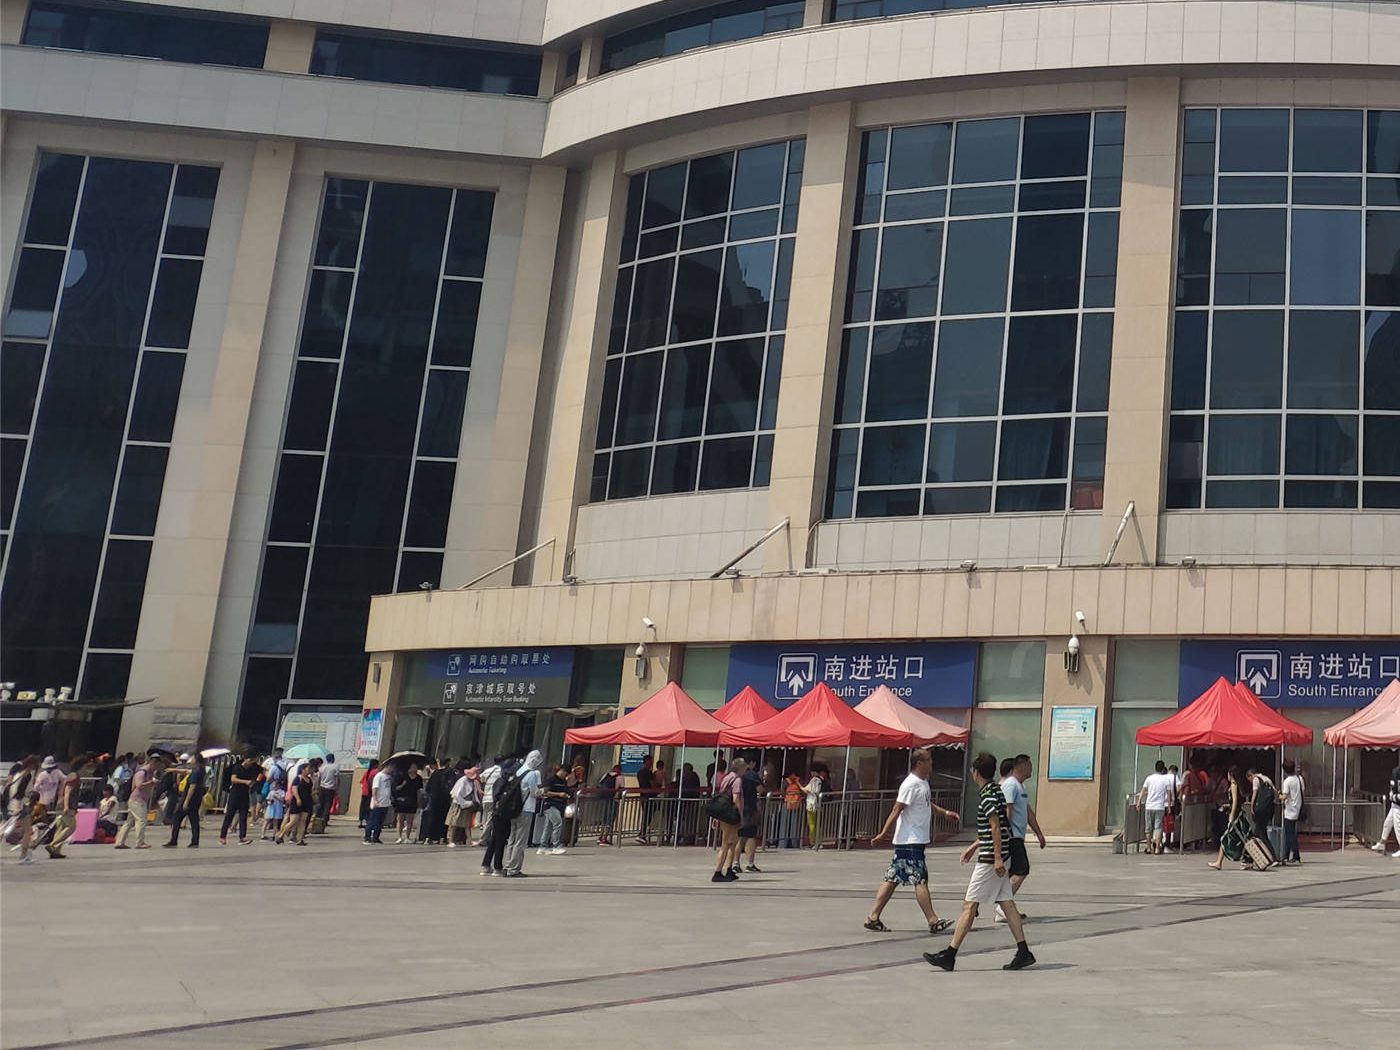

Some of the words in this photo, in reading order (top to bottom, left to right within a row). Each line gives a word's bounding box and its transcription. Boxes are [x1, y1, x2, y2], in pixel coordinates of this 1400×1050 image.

[823, 653, 924, 681] 南进站口
[1289, 652, 1400, 679] 南进站口
[830, 685, 855, 697] outh
[1288, 683, 1327, 696] South
[1330, 684, 1384, 697] Entranc
